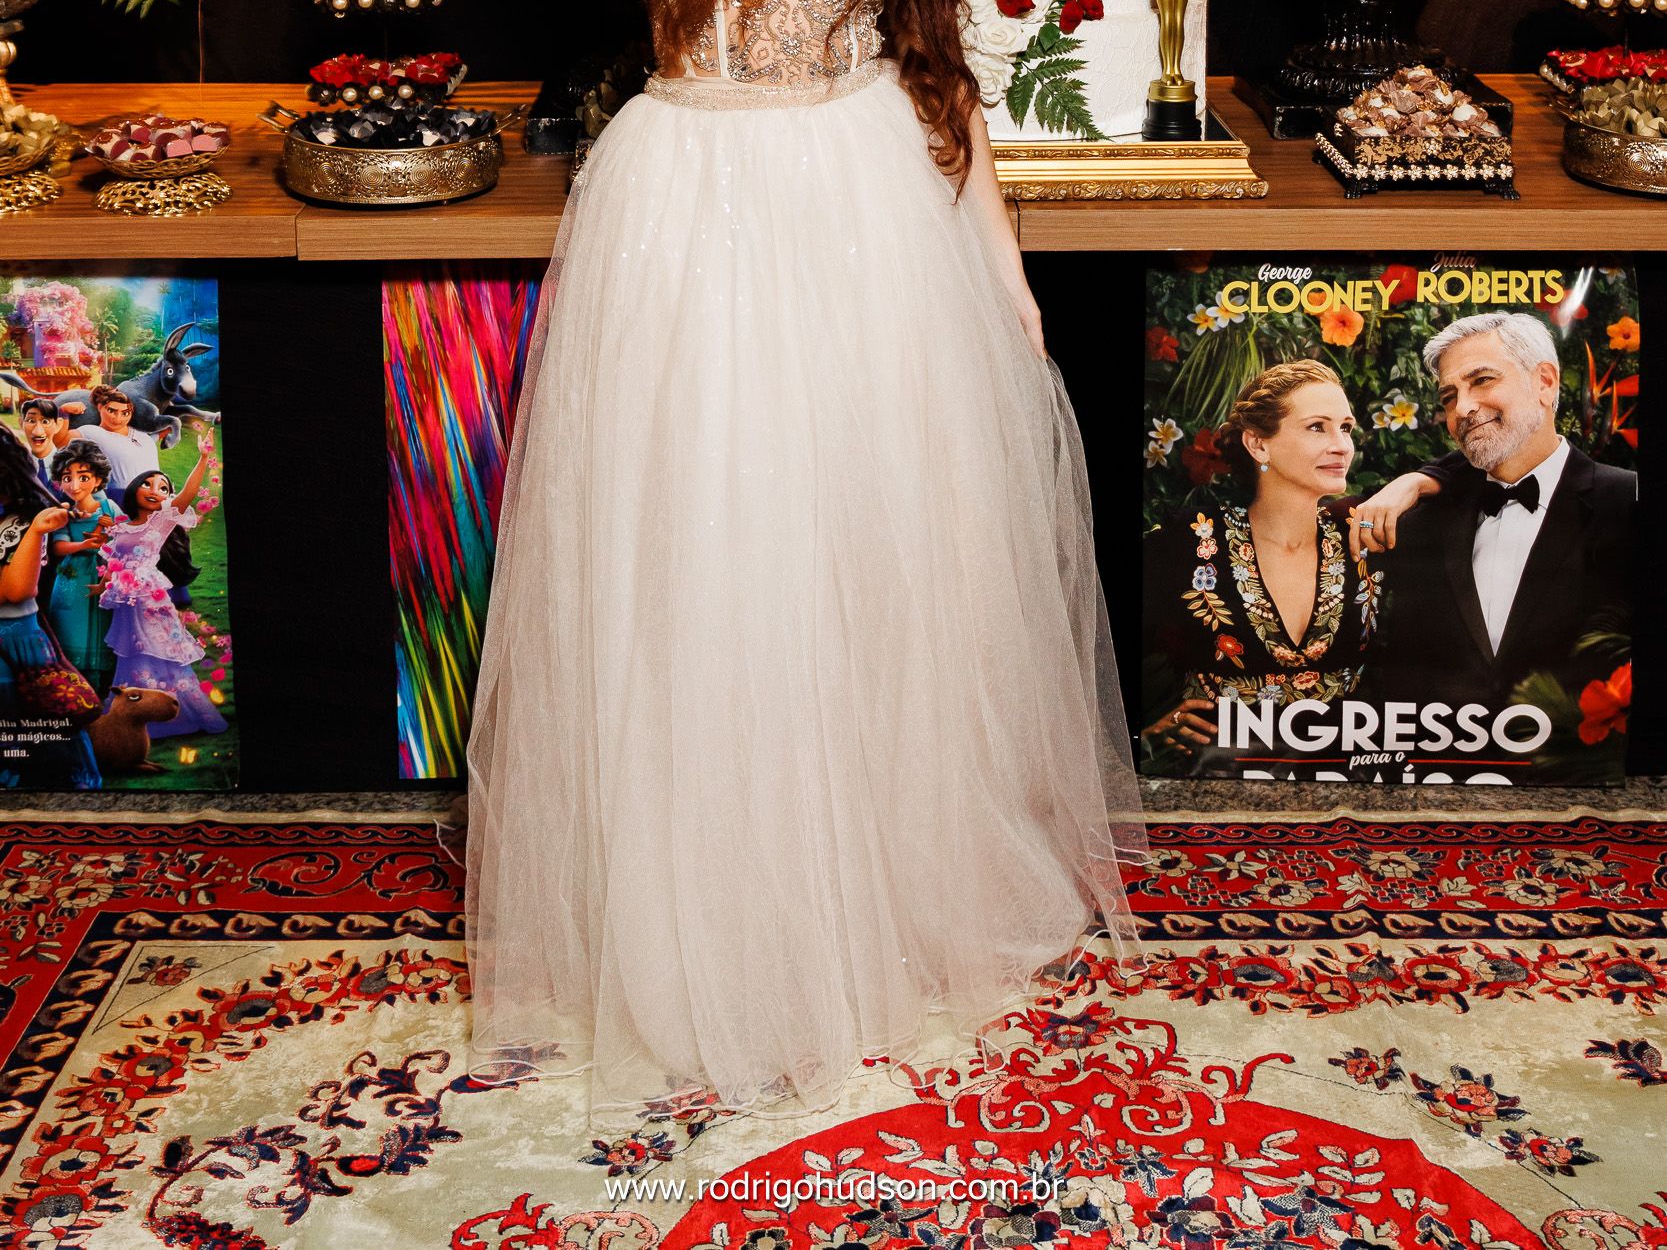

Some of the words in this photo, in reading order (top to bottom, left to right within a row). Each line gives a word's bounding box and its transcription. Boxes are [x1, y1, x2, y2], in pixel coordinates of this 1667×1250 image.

[1431, 252, 1477, 273] Julia
[1258, 263, 1312, 284] George
[1221, 279, 1400, 314] CLOONEY
[1416, 270, 1564, 304] ROBERTS
[20, 717, 73, 729] Madrigal.
[1218, 696, 1552, 752] INGRESSO
[17, 732, 71, 743] mágicos...
[4, 749, 30, 757] uma.
[1349, 752, 1392, 770] para
[1395, 751, 1406, 763] o
